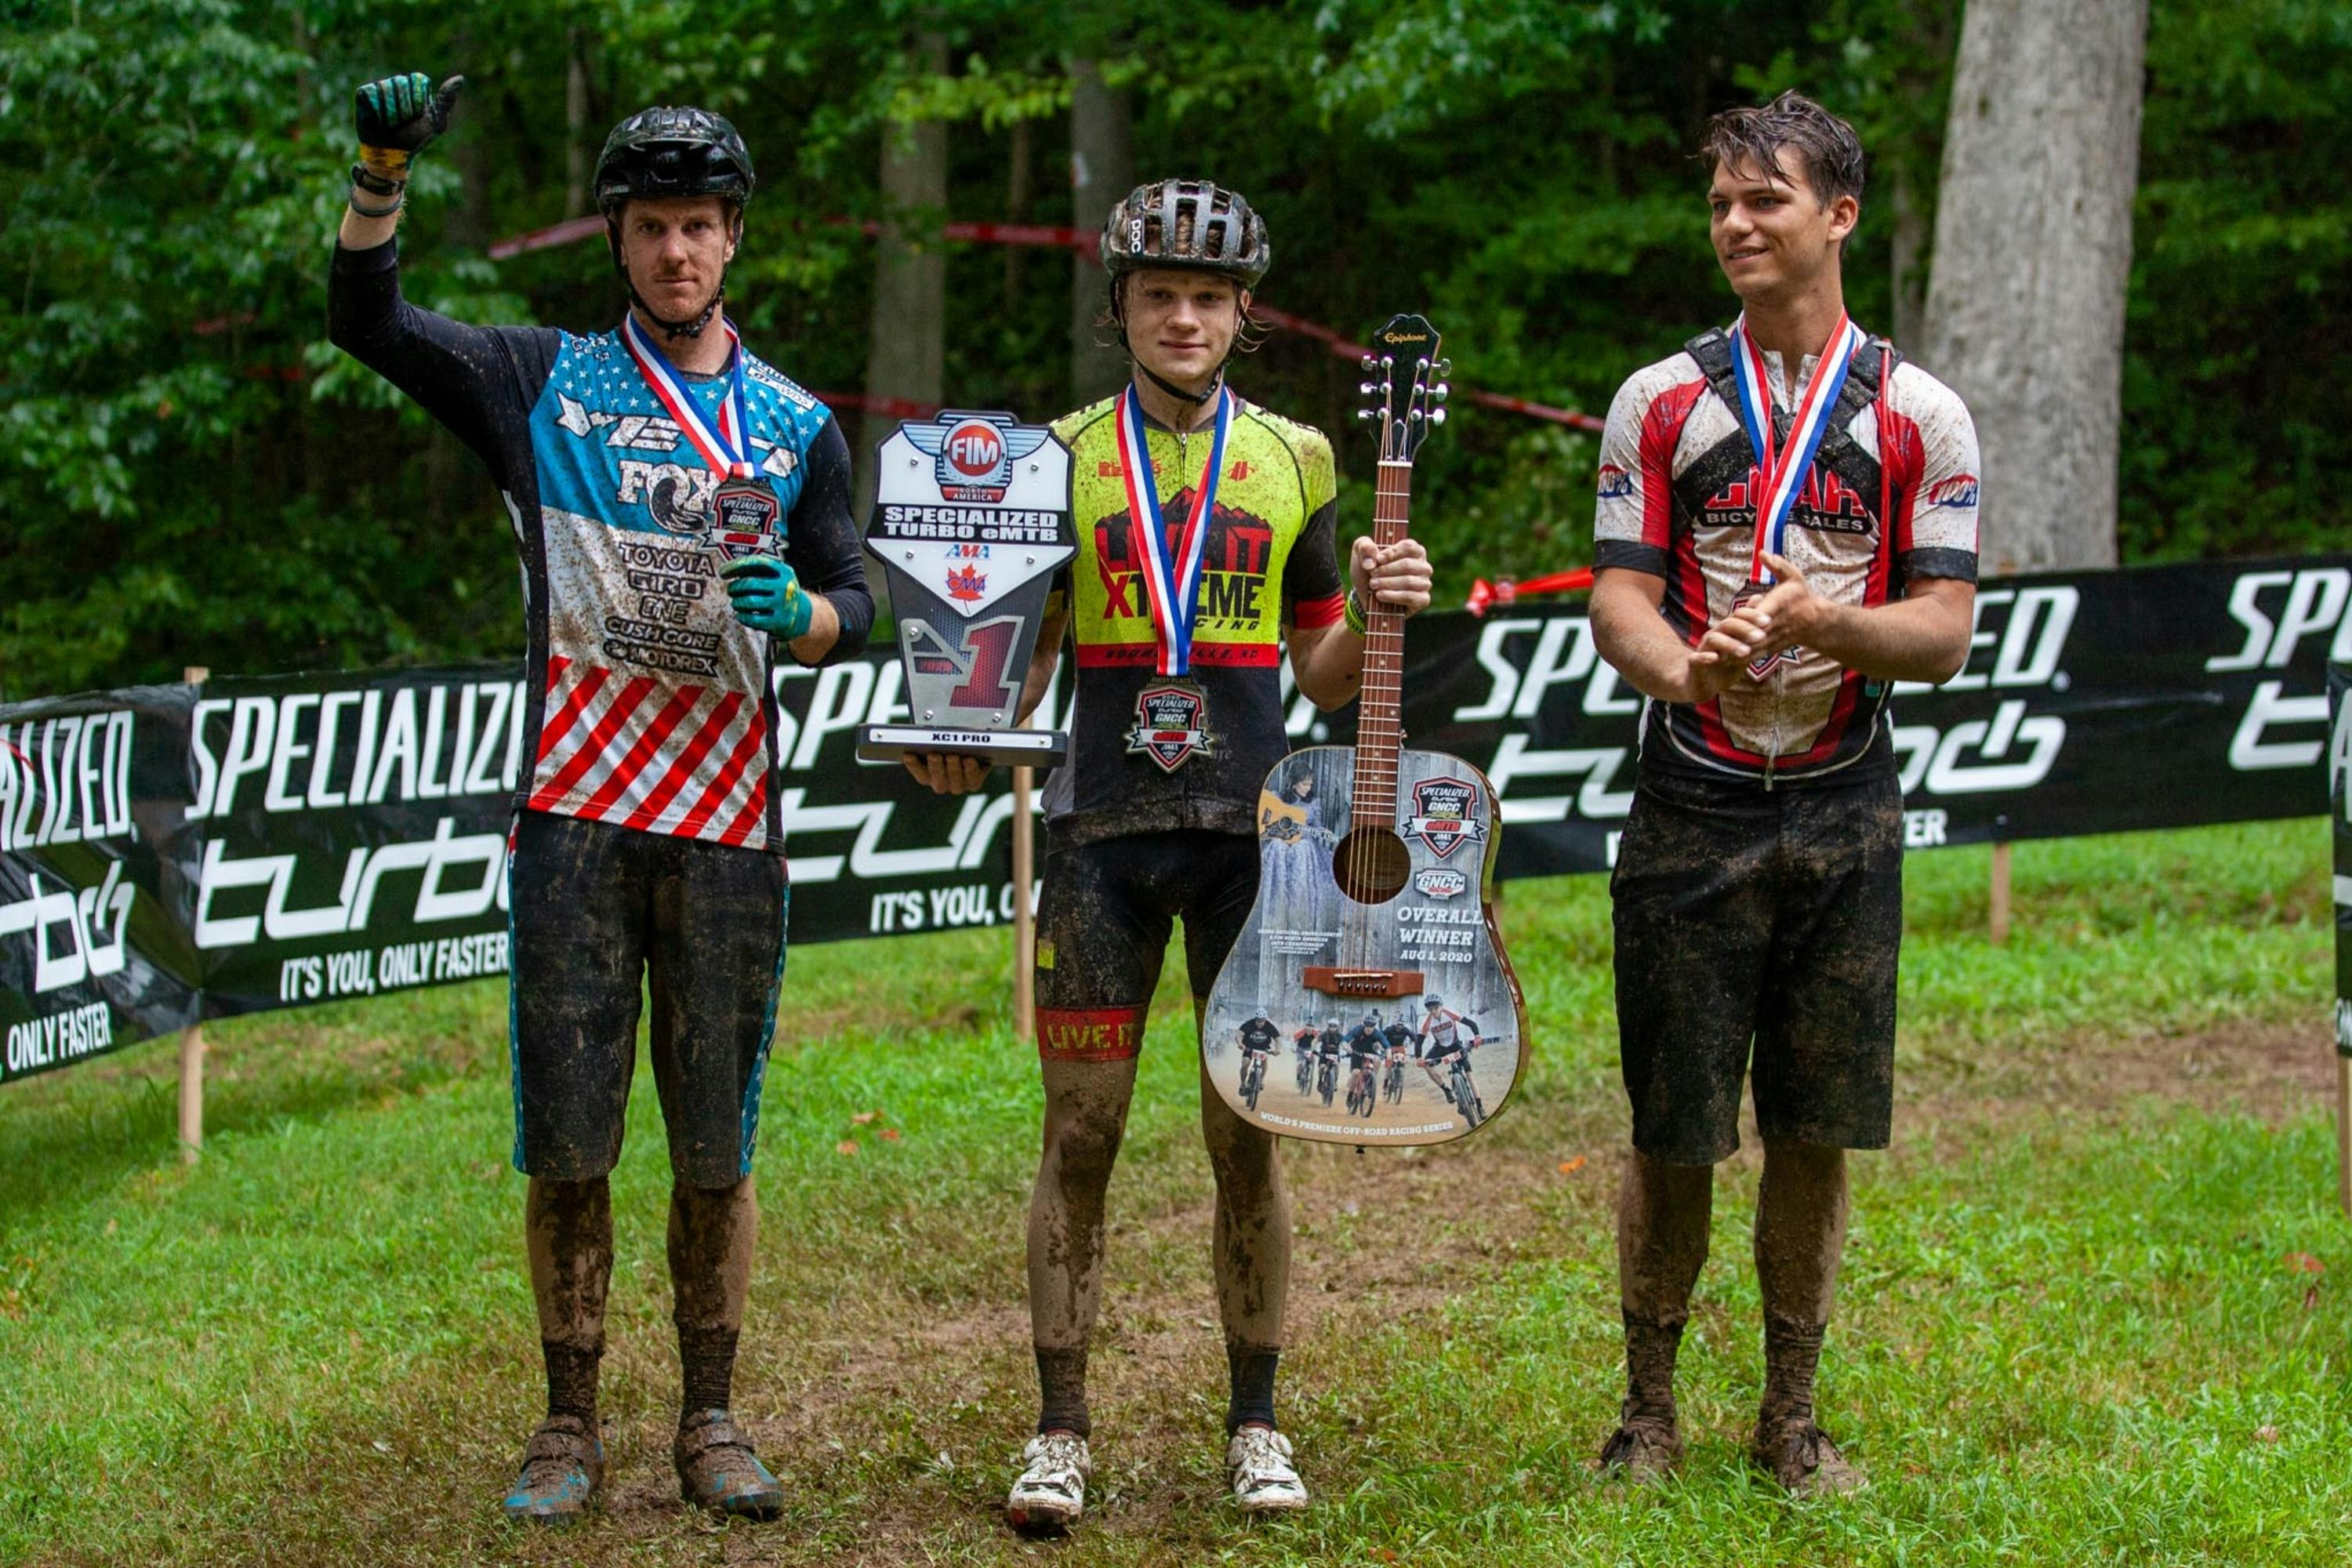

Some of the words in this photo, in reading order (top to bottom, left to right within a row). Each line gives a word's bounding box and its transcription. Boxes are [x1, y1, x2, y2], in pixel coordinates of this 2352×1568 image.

[1385, 332, 1427, 343] Epiphone
[952, 436, 998, 465] FIM
[722, 499, 771, 512] SPECIALIZED
[728, 514, 761, 526] GNCC
[884, 506, 1058, 528] SPECIALIZED
[1706, 511, 1795, 524] BICYE
[884, 521, 975, 539] TURBO
[981, 527, 1058, 543] eMTB
[619, 542, 716, 577] TOYOTA
[946, 544, 989, 558] AMA
[628, 569, 703, 599] GIRO
[1099, 572, 1267, 619] XTEME
[661, 628, 721, 652] CORE
[626, 642, 719, 678] MOTOREX
[949, 620, 1018, 710] 1
[1147, 699, 1196, 709] SPECIALIZED
[1154, 713, 1187, 723] GNCC
[931, 733, 958, 742] XC1
[962, 735, 991, 743] PRO
[1420, 787, 1470, 798] SPECIALIZED
[1428, 801, 1461, 812] GNCC
[1417, 875, 1464, 889] GNCC
[870, 891, 925, 933] IT'S
[930, 884, 996, 927] YOU,
[1397, 906, 1484, 924] OVERALL
[1399, 928, 1474, 946] WINNER
[1400, 949, 1425, 960] AUG
[1439, 952, 1472, 963] 2020
[280, 955, 324, 1002] IT'S
[326, 949, 376, 996] YOU,
[379, 942, 434, 988] ONLY
[435, 931, 510, 980] FASTER
[7, 1015, 56, 1073] ONLY
[59, 1000, 111, 1058] FASTER
[1047, 1025, 1111, 1049] LIVE
[1260, 1111, 1298, 1127] WORLD'S
[1343, 1126, 1388, 1136] OFF-ROAD
[1389, 1127, 1421, 1136] RACING
[1423, 1121, 1454, 1134] SERIES
